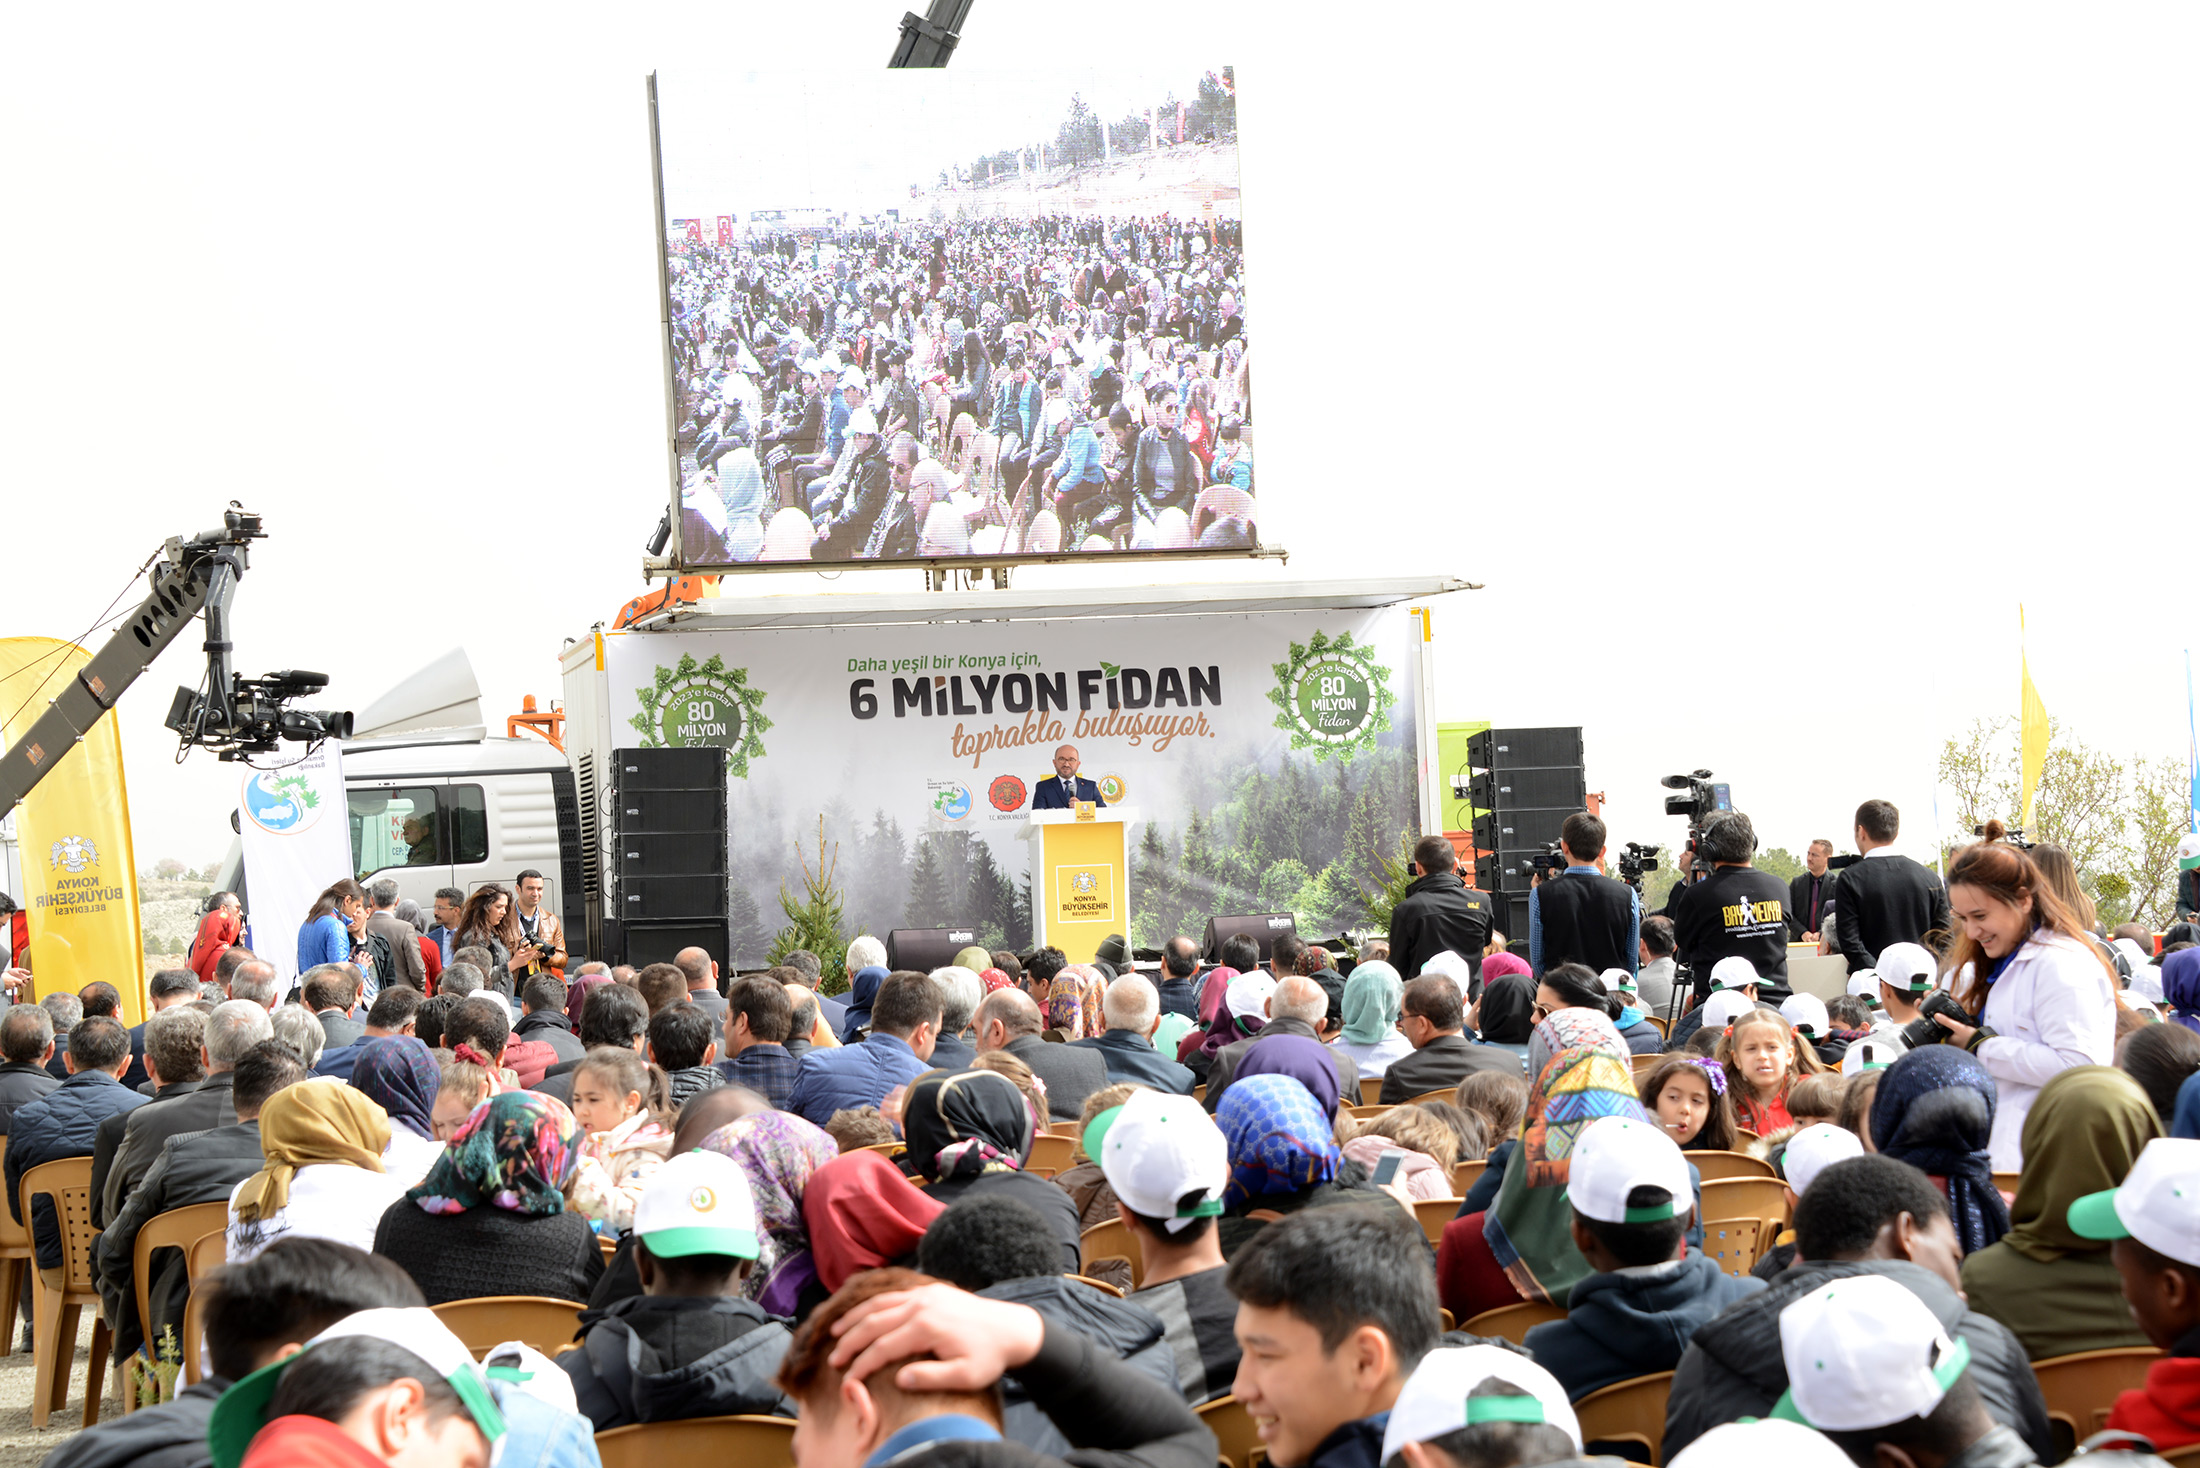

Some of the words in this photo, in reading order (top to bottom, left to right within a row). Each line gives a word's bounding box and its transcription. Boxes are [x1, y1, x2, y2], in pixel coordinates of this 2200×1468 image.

[848, 657, 888, 672] Daha
[891, 656, 928, 674] yeşil
[932, 654, 954, 669] bir
[958, 654, 1006, 670] Konya
[1010, 652, 1042, 671] için,
[1303, 664, 1333, 686] 2023'e
[1334, 664, 1364, 684] kadar
[1320, 676, 1346, 696] 80
[670, 689, 702, 712] 2023'e
[703, 688, 734, 708] kadar
[849, 678, 878, 720] 6
[892, 672, 1068, 718] MİLYON
[1077, 662, 1222, 710] FİDAN
[687, 700, 715, 722] 80
[1311, 696, 1357, 712] MİLYON
[677, 722, 727, 738] MİLYON
[1317, 712, 1352, 728] Fidan
[951, 709, 1066, 768] toprakla
[1072, 701, 1216, 753] buluşuyor.
[1062, 902, 1108, 912] BÜYÜKŞEHİR
[1722, 904, 1744, 927] BAY
[1750, 901, 1783, 923] MEDYA
